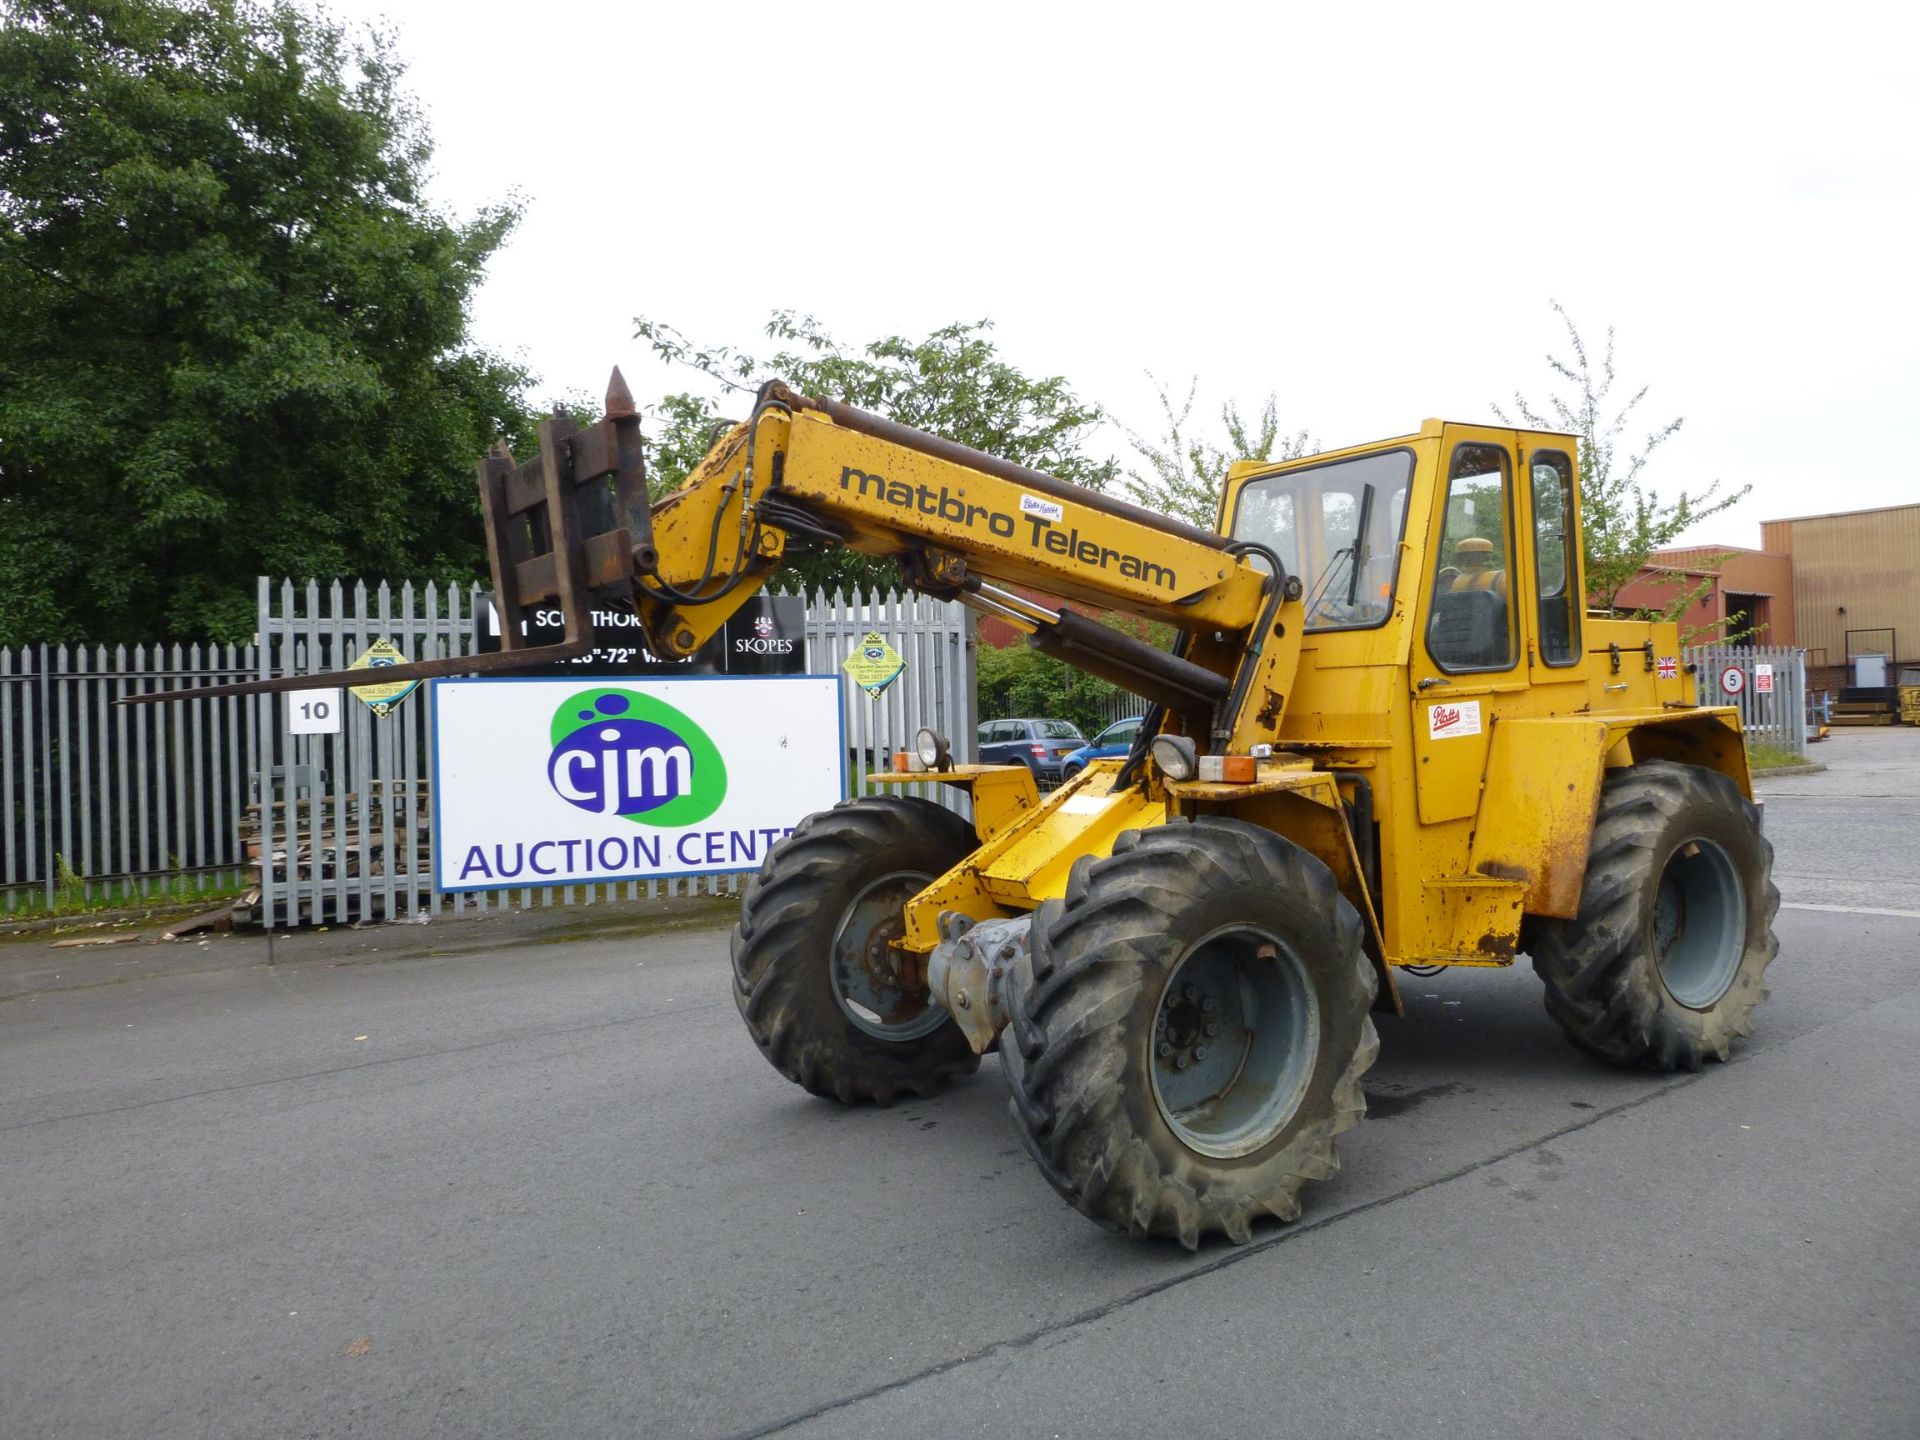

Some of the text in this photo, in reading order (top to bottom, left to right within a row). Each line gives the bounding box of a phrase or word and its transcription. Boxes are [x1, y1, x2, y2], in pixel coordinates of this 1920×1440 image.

[840, 466, 1176, 591] matbro Teleram
[736, 638, 793, 654] SKOPES
[1729, 674, 1737, 687] 5
[300, 701, 330, 720] 10
[553, 728, 692, 816] cjm
[459, 828, 796, 880] AUCTION CENT
